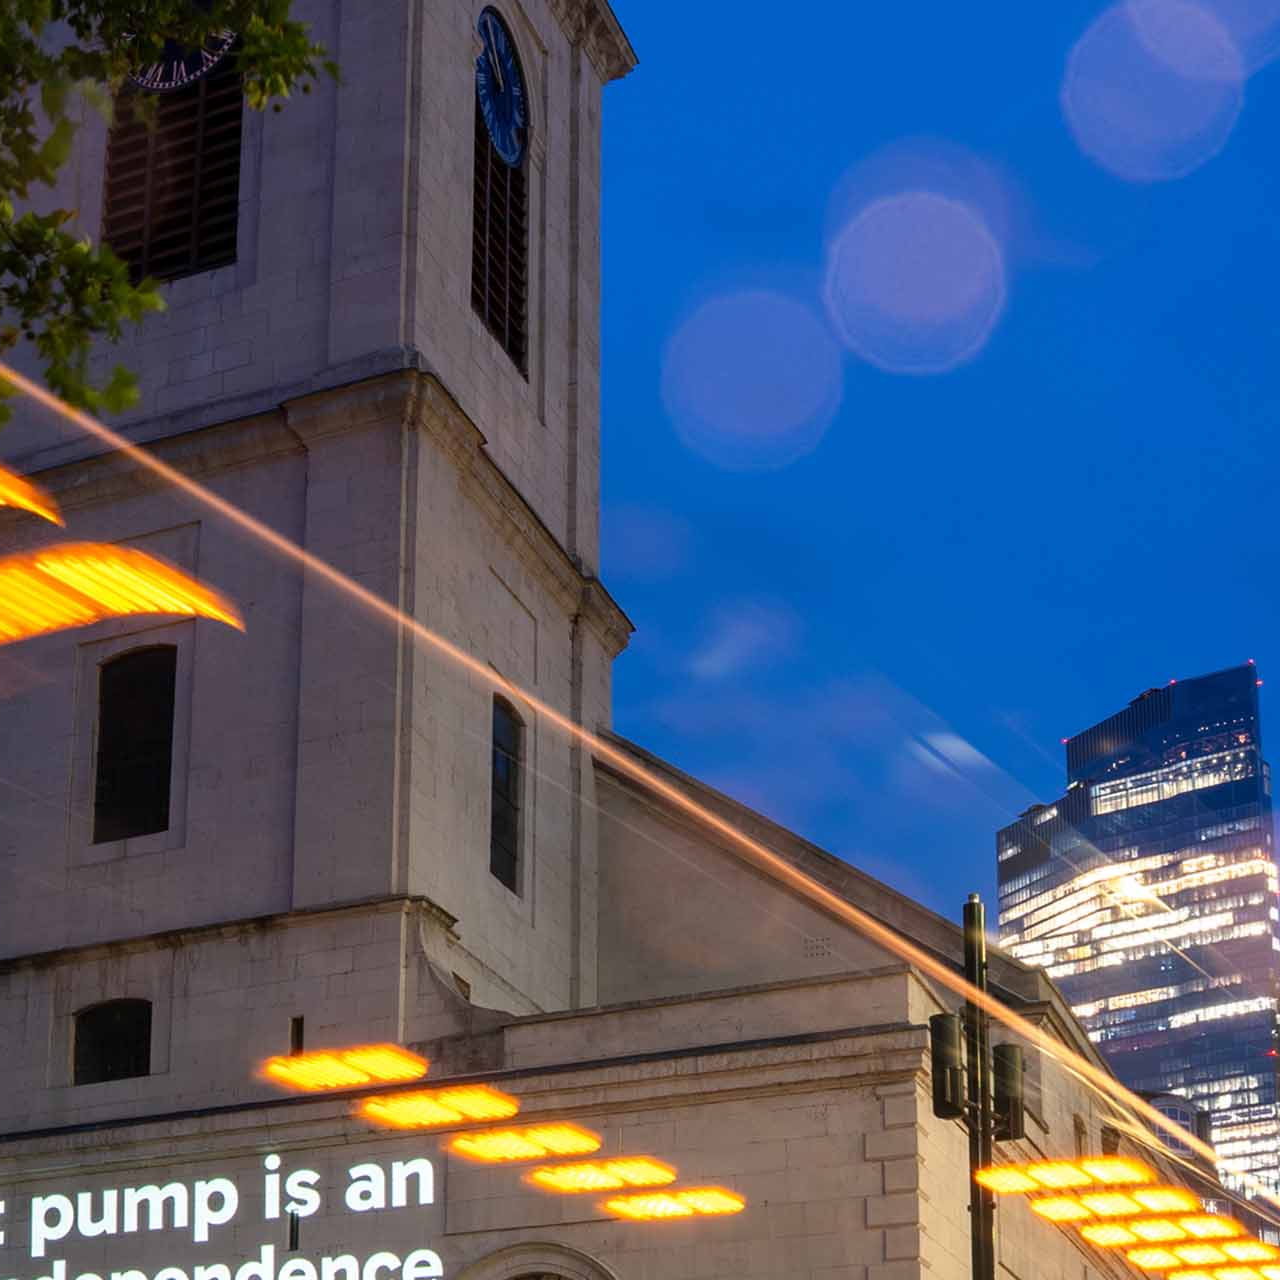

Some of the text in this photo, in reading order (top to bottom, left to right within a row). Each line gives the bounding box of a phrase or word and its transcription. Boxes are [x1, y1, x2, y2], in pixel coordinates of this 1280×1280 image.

[31, 1177, 239, 1258] pump
[264, 1153, 321, 1220] is
[345, 1157, 435, 1212] an
